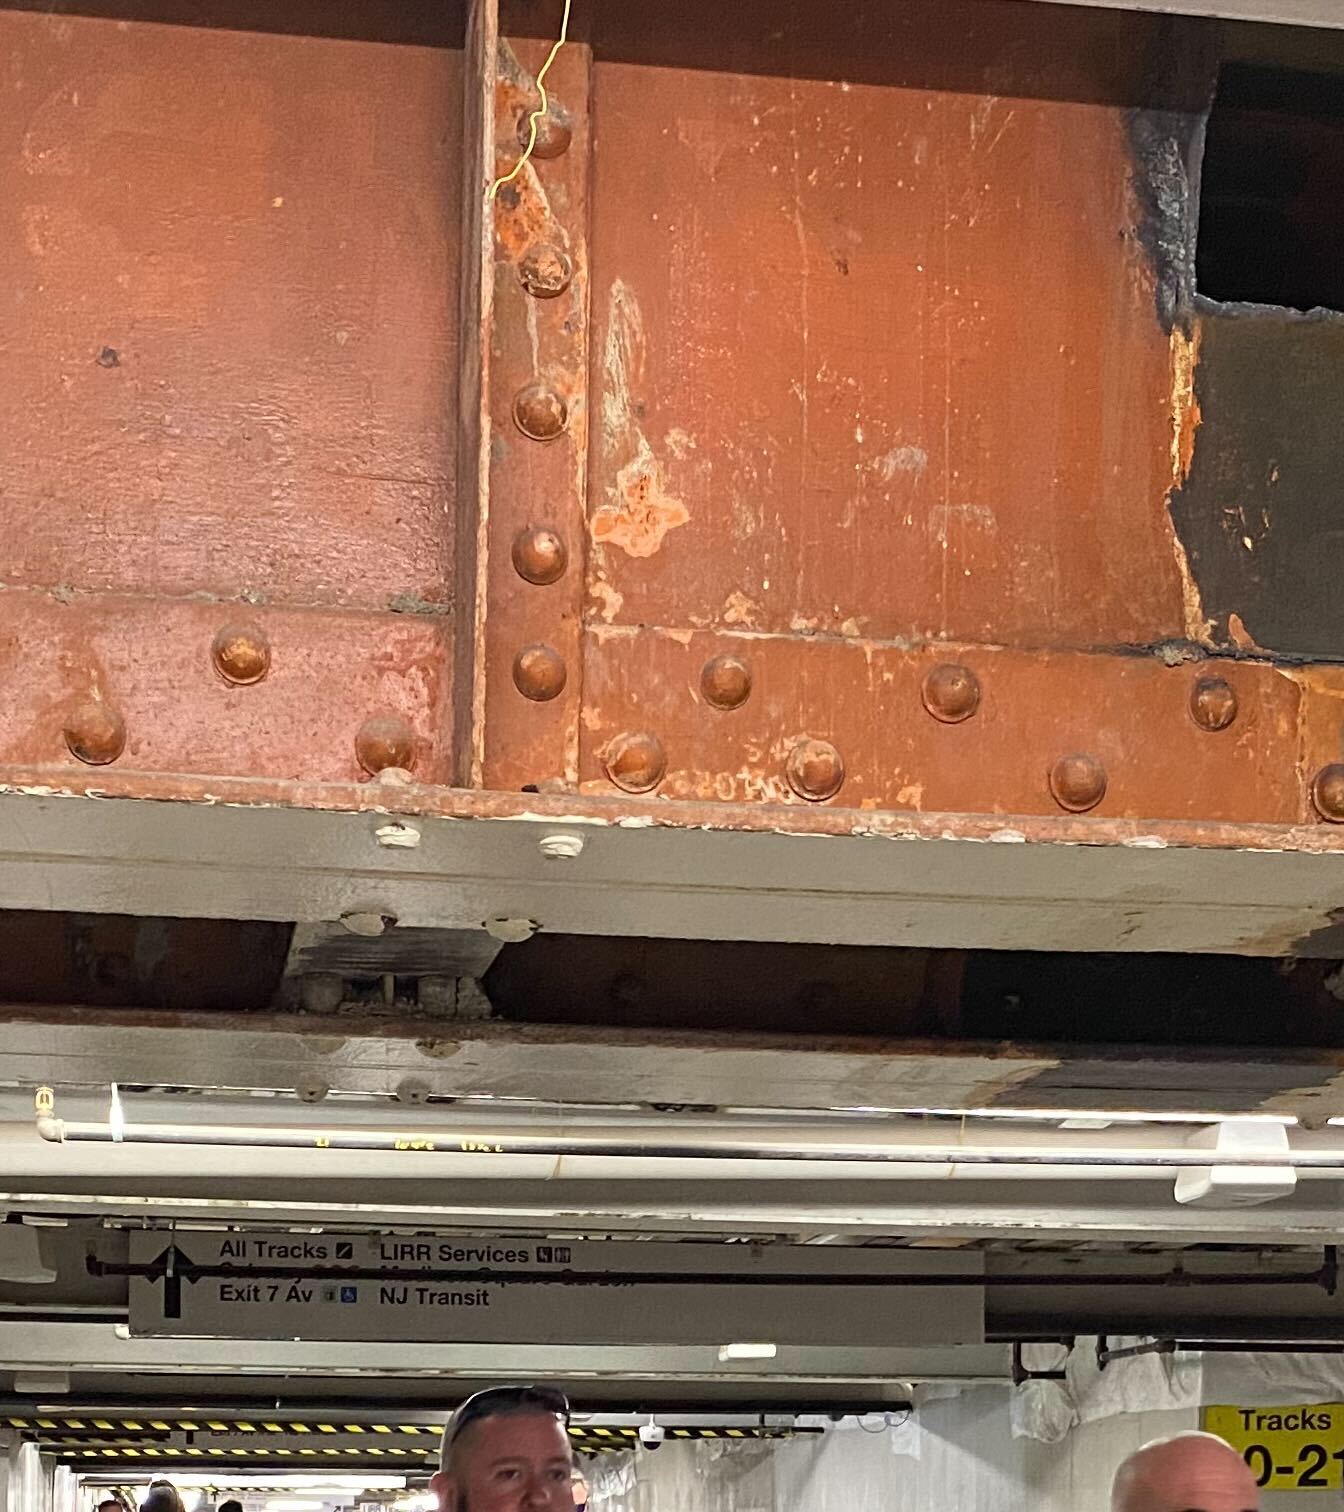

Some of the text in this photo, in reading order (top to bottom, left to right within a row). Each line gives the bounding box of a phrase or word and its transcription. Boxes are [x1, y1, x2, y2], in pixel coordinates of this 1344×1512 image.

[219, 1240, 328, 1259] All Tracks
[380, 1244, 529, 1263] LIRR Services
[220, 1284, 313, 1303] Exit 7 Av
[380, 1287, 490, 1306] NJ Transit
[1238, 1408, 1332, 1431] Tracks
